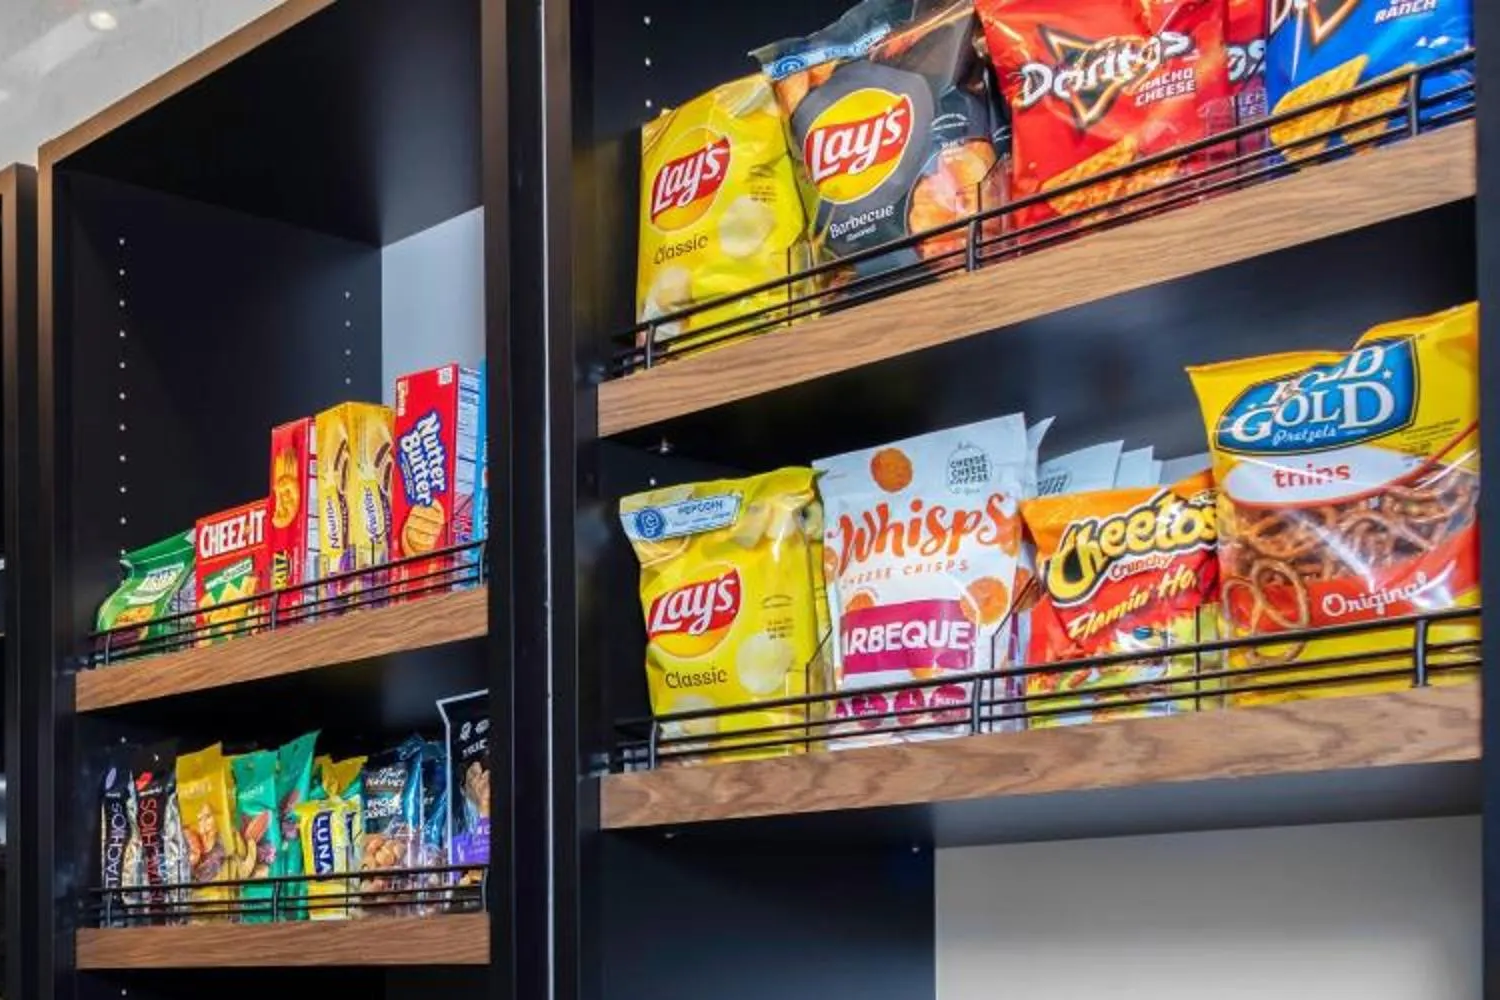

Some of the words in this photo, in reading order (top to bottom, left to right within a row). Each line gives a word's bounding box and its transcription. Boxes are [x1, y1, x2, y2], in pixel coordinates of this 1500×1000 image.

[1019, 31, 1194, 106] Doritos
[1134, 79, 1196, 107] CHEESE
[1140, 67, 1194, 93] NACHO
[809, 105, 907, 184] Lay's
[652, 142, 730, 215] Lay's
[830, 205, 894, 239] Barbecue
[654, 235, 709, 265] Classic
[1231, 381, 1395, 442] GOLD
[1271, 424, 1338, 446] Pretzels
[401, 431, 431, 506] Butter
[418, 412, 446, 491] Nutter
[201, 509, 267, 559] CHEEZ-IT
[838, 492, 1011, 577] Whisps
[1048, 492, 1217, 600] Cheetos
[903, 559, 970, 575] CRISPS
[1110, 554, 1173, 580] Crunchy
[1157, 563, 1198, 598] Ho
[652, 574, 737, 636] Lay's
[844, 618, 973, 655] RBEQUE
[665, 665, 729, 689] Classic
[315, 815, 332, 875] LUNA
